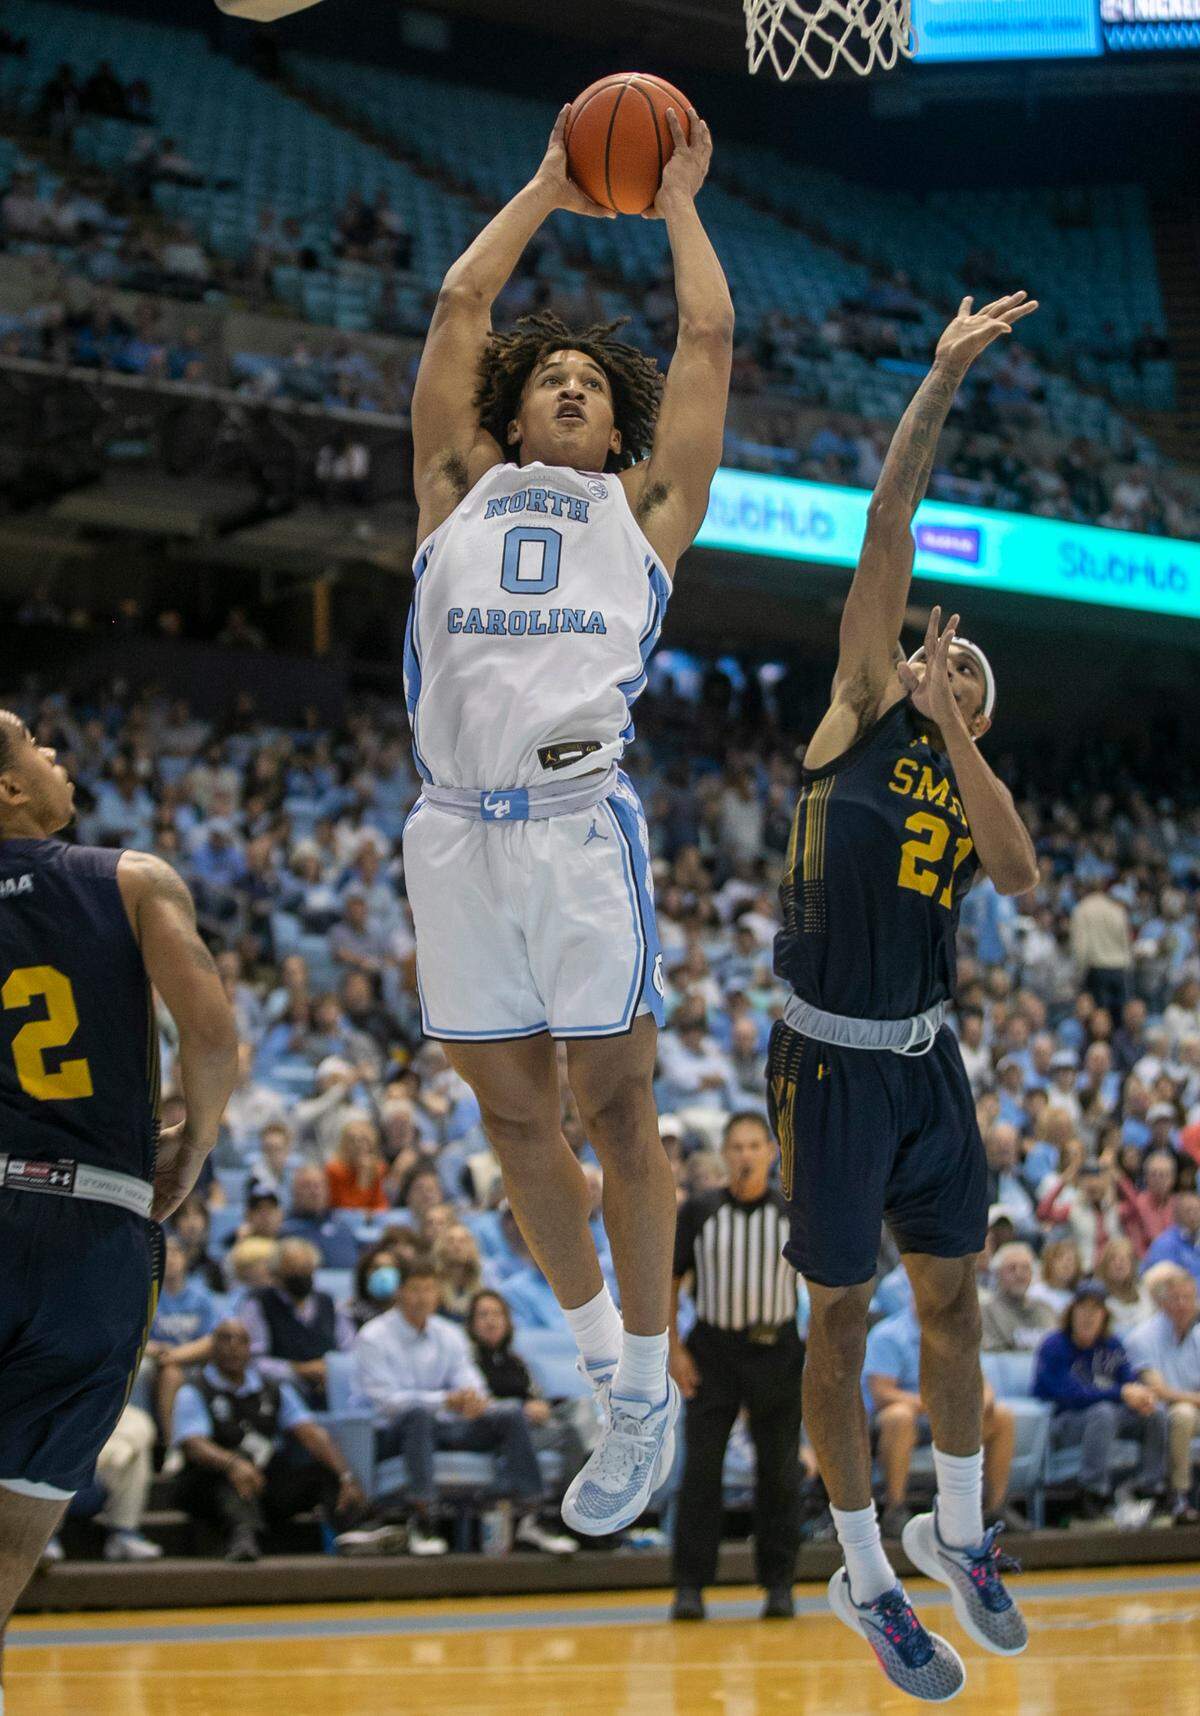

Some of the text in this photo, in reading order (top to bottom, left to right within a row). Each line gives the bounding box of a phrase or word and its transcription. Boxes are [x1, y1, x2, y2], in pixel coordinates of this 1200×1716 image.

[484, 488, 590, 523] NORTH
[708, 490, 835, 541] tubHub
[500, 526, 562, 594] 0
[1058, 538, 1190, 595] StubHub
[447, 607, 607, 635] CAROLINA
[897, 811, 973, 910] 21
[1, 964, 94, 1101] 2
